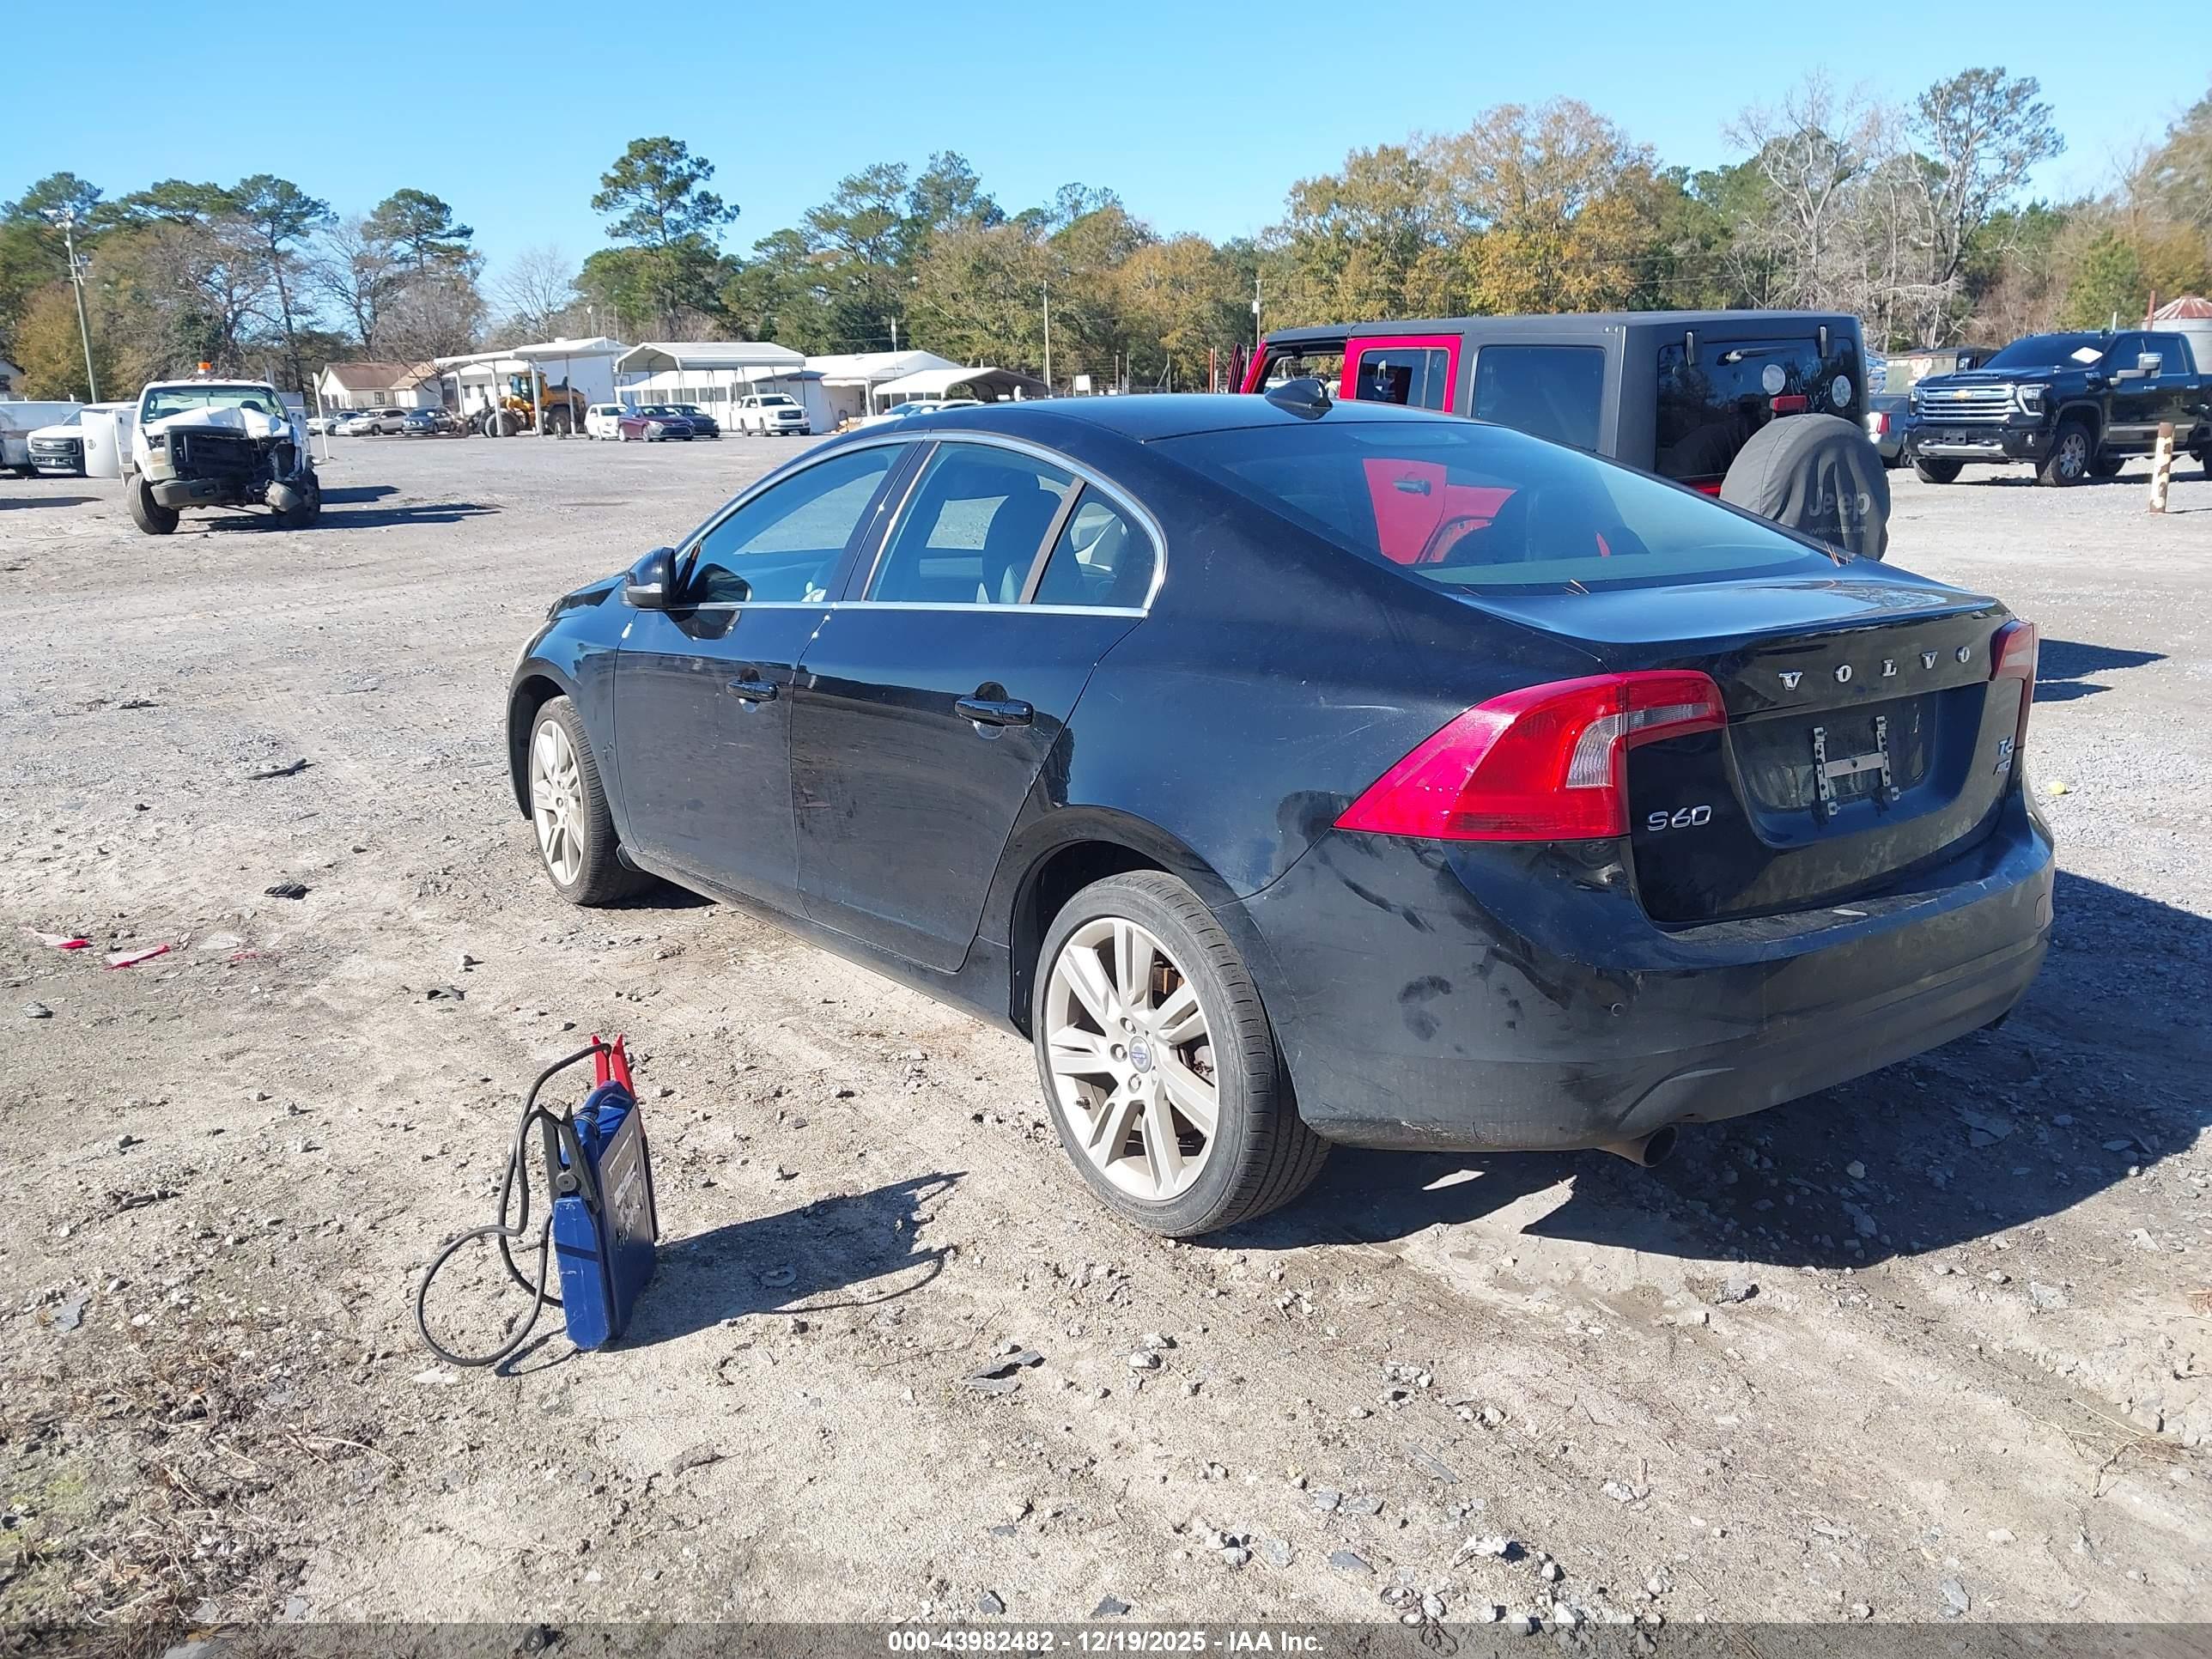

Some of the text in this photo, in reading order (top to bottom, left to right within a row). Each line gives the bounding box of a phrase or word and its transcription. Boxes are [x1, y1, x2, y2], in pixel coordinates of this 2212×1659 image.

[1808, 487, 1870, 521] Jeep
[1778, 646, 1971, 691] VOLVO
[1647, 805, 1711, 831] S60
